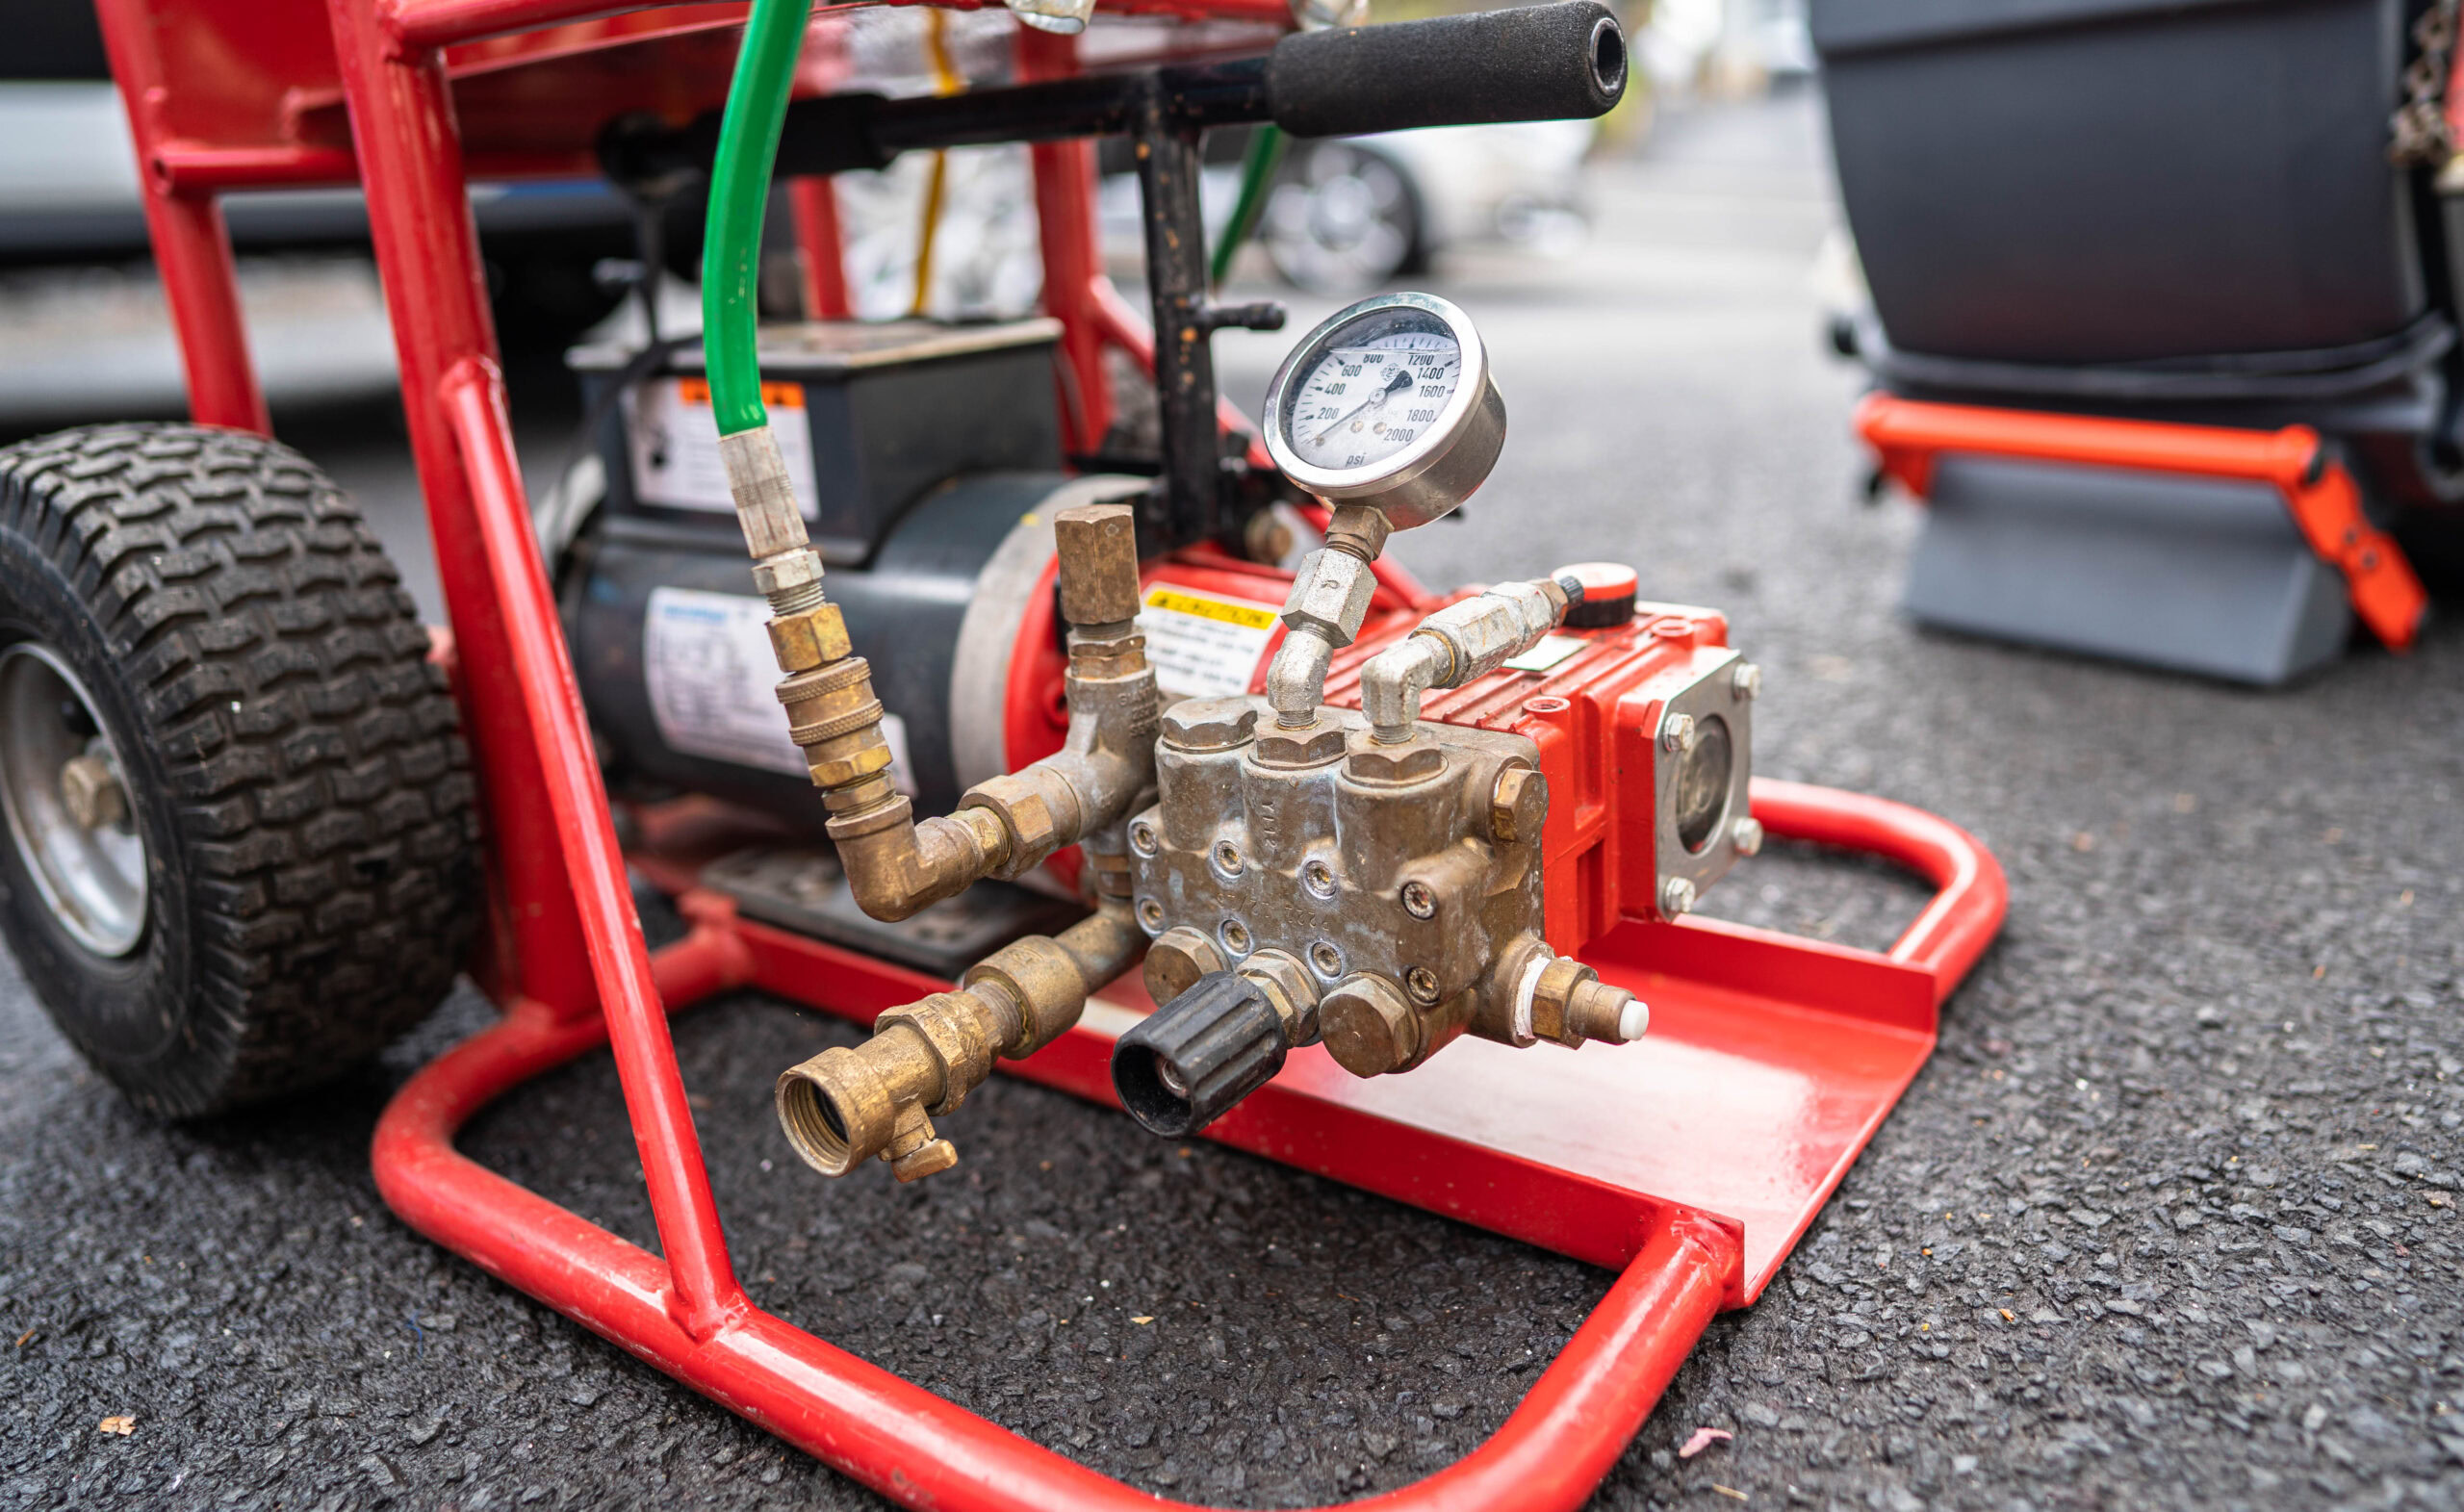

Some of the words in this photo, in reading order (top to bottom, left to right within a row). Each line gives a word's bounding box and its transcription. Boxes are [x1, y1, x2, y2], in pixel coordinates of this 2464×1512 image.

[1363, 353, 1384, 364] 800
[1407, 354, 1435, 366] 1200
[1341, 365, 1363, 377] 600
[1417, 367, 1445, 380] 1400
[1324, 383, 1347, 396] 400
[1419, 385, 1446, 398] 1600
[1317, 407, 1340, 420] 200
[1407, 409, 1434, 423] 1800
[1384, 428, 1414, 443] 2000
[1345, 451, 1367, 468] psi
